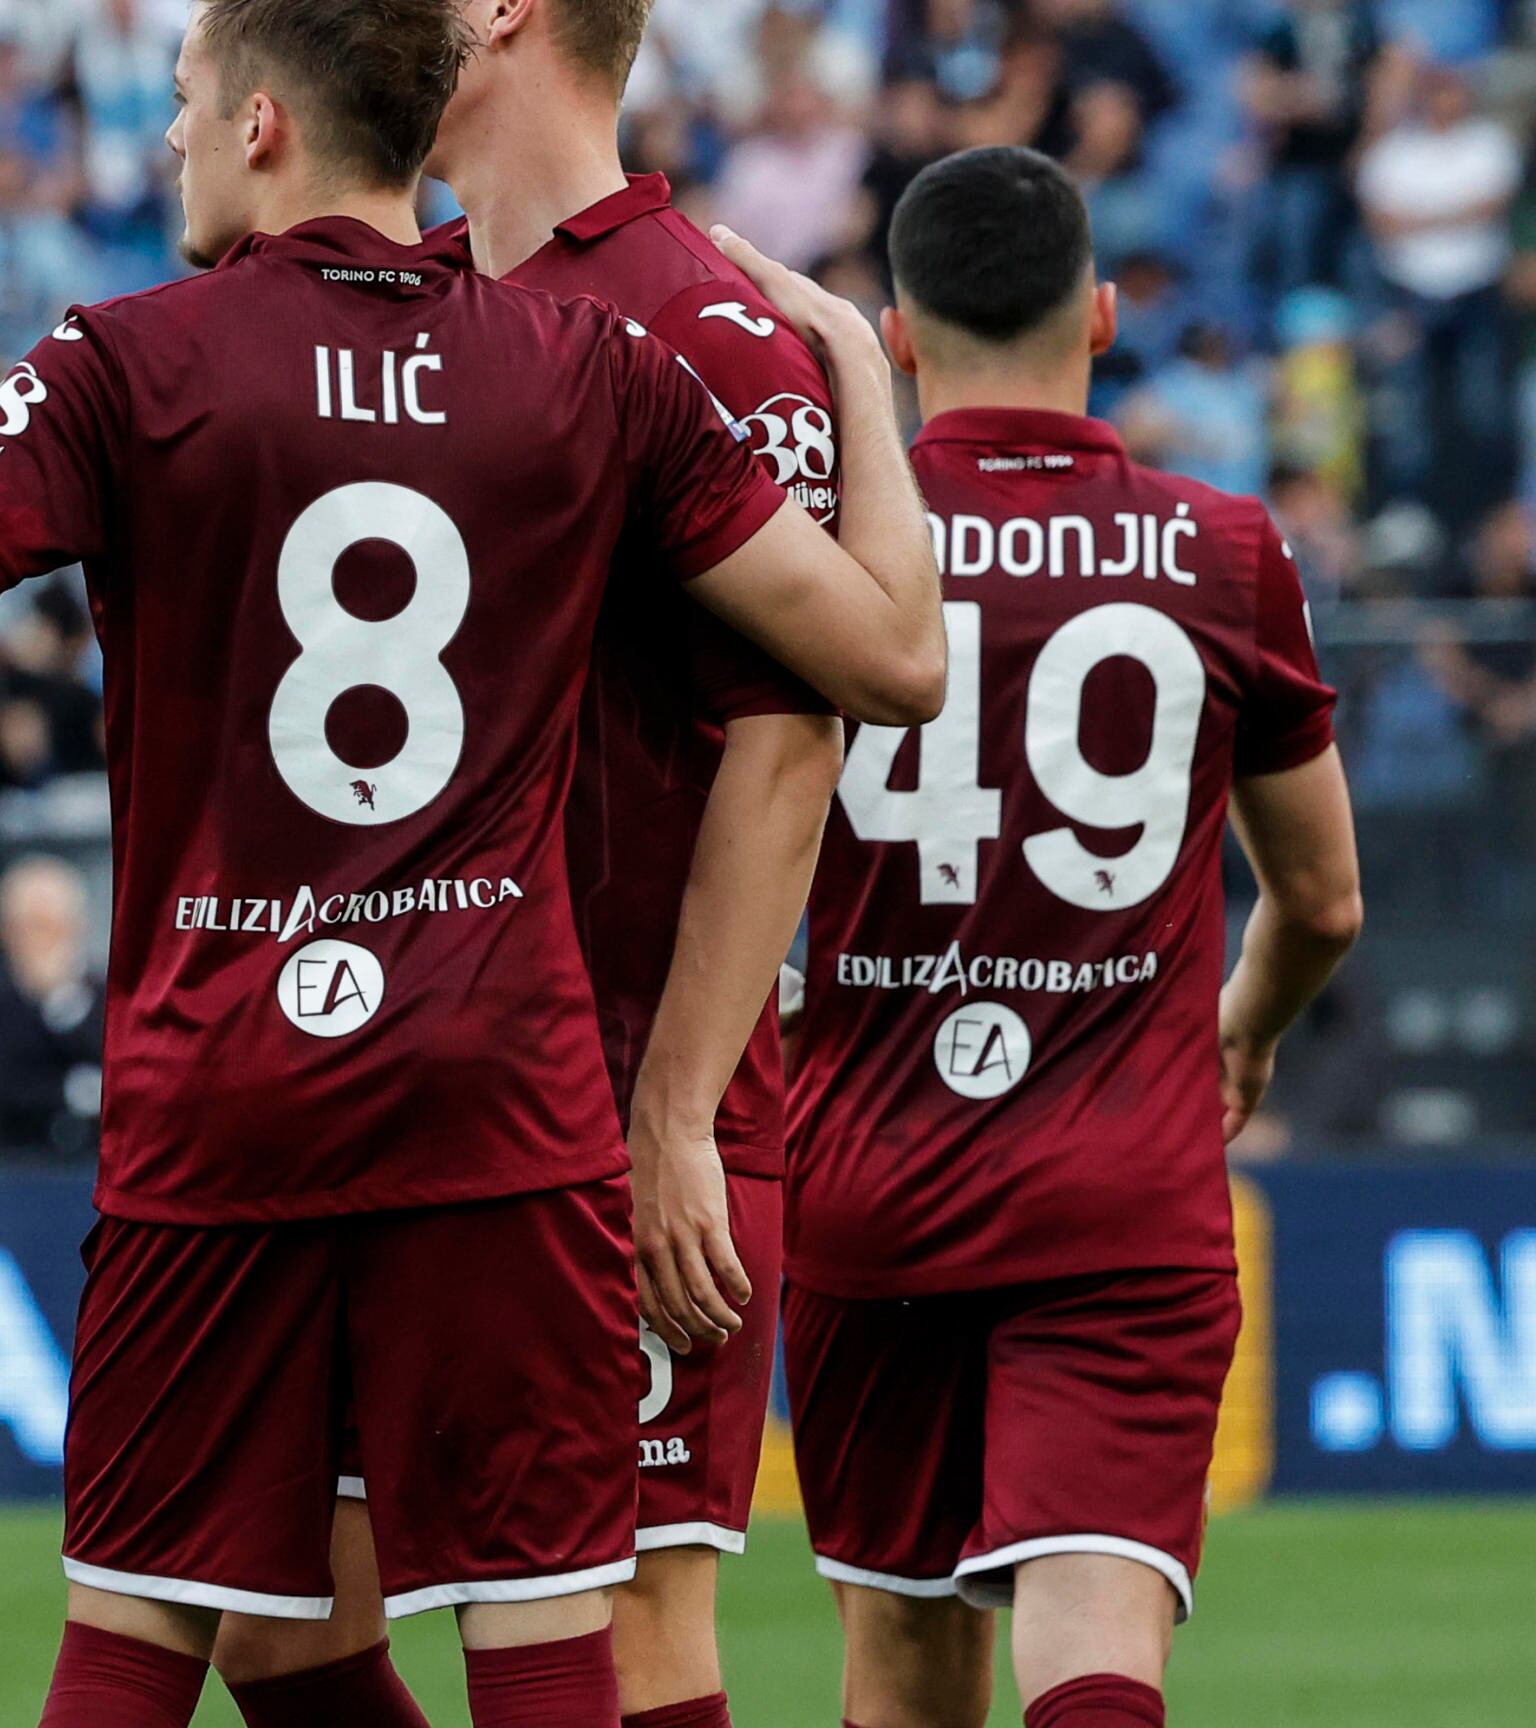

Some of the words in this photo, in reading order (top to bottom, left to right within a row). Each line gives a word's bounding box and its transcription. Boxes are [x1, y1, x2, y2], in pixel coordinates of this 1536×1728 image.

[321, 269, 375, 281] TORINO
[378, 271, 396, 282] FC
[399, 272, 421, 286] 1906
[314, 332, 447, 424] ILIĆ
[738, 406, 835, 486] 38
[268, 481, 471, 826] 8
[837, 600, 1206, 911] 49
[297, 959, 369, 1017] EA
[949, 1019, 1012, 1082] EA
